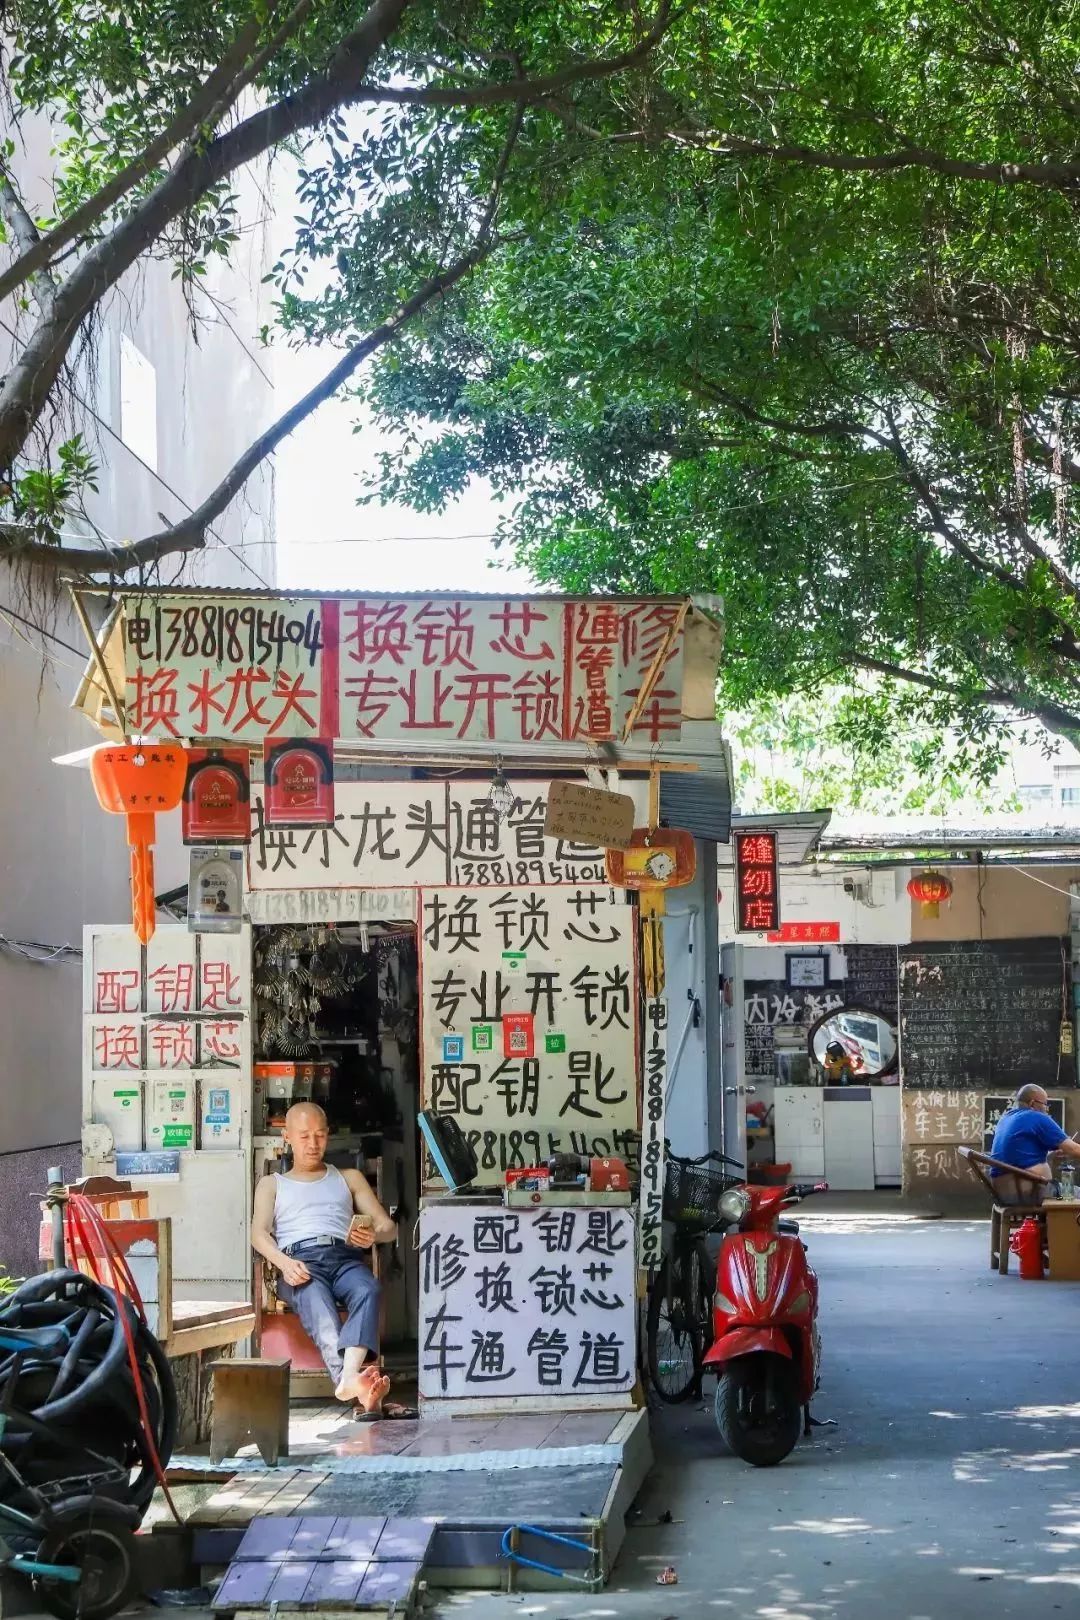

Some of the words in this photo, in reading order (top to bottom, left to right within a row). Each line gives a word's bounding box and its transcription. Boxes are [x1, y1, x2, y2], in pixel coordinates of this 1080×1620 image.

[127, 605, 324, 667] 电13881895404
[344, 601, 555, 671] 换锁芯
[126, 666, 318, 736] 换水龙头
[344, 668, 562, 740] 专业开锁
[571, 603, 620, 741] 通管道
[619, 603, 685, 742] 修车
[450, 796, 606, 861] 通管
[741, 837, 774, 928] 缝纫店
[424, 890, 621, 953] 换锁芯
[96, 963, 242, 1014] 配钥匙
[431, 964, 630, 1032] 专业开锁
[95, 1022, 241, 1069] 换锁芯
[432, 1050, 628, 1118] 配钥匙
[474, 1211, 629, 1256] 配钥匙
[421, 1232, 470, 1392] 修车
[474, 1261, 625, 1316] 换锁芯
[466, 1328, 631, 1388] 通管道
